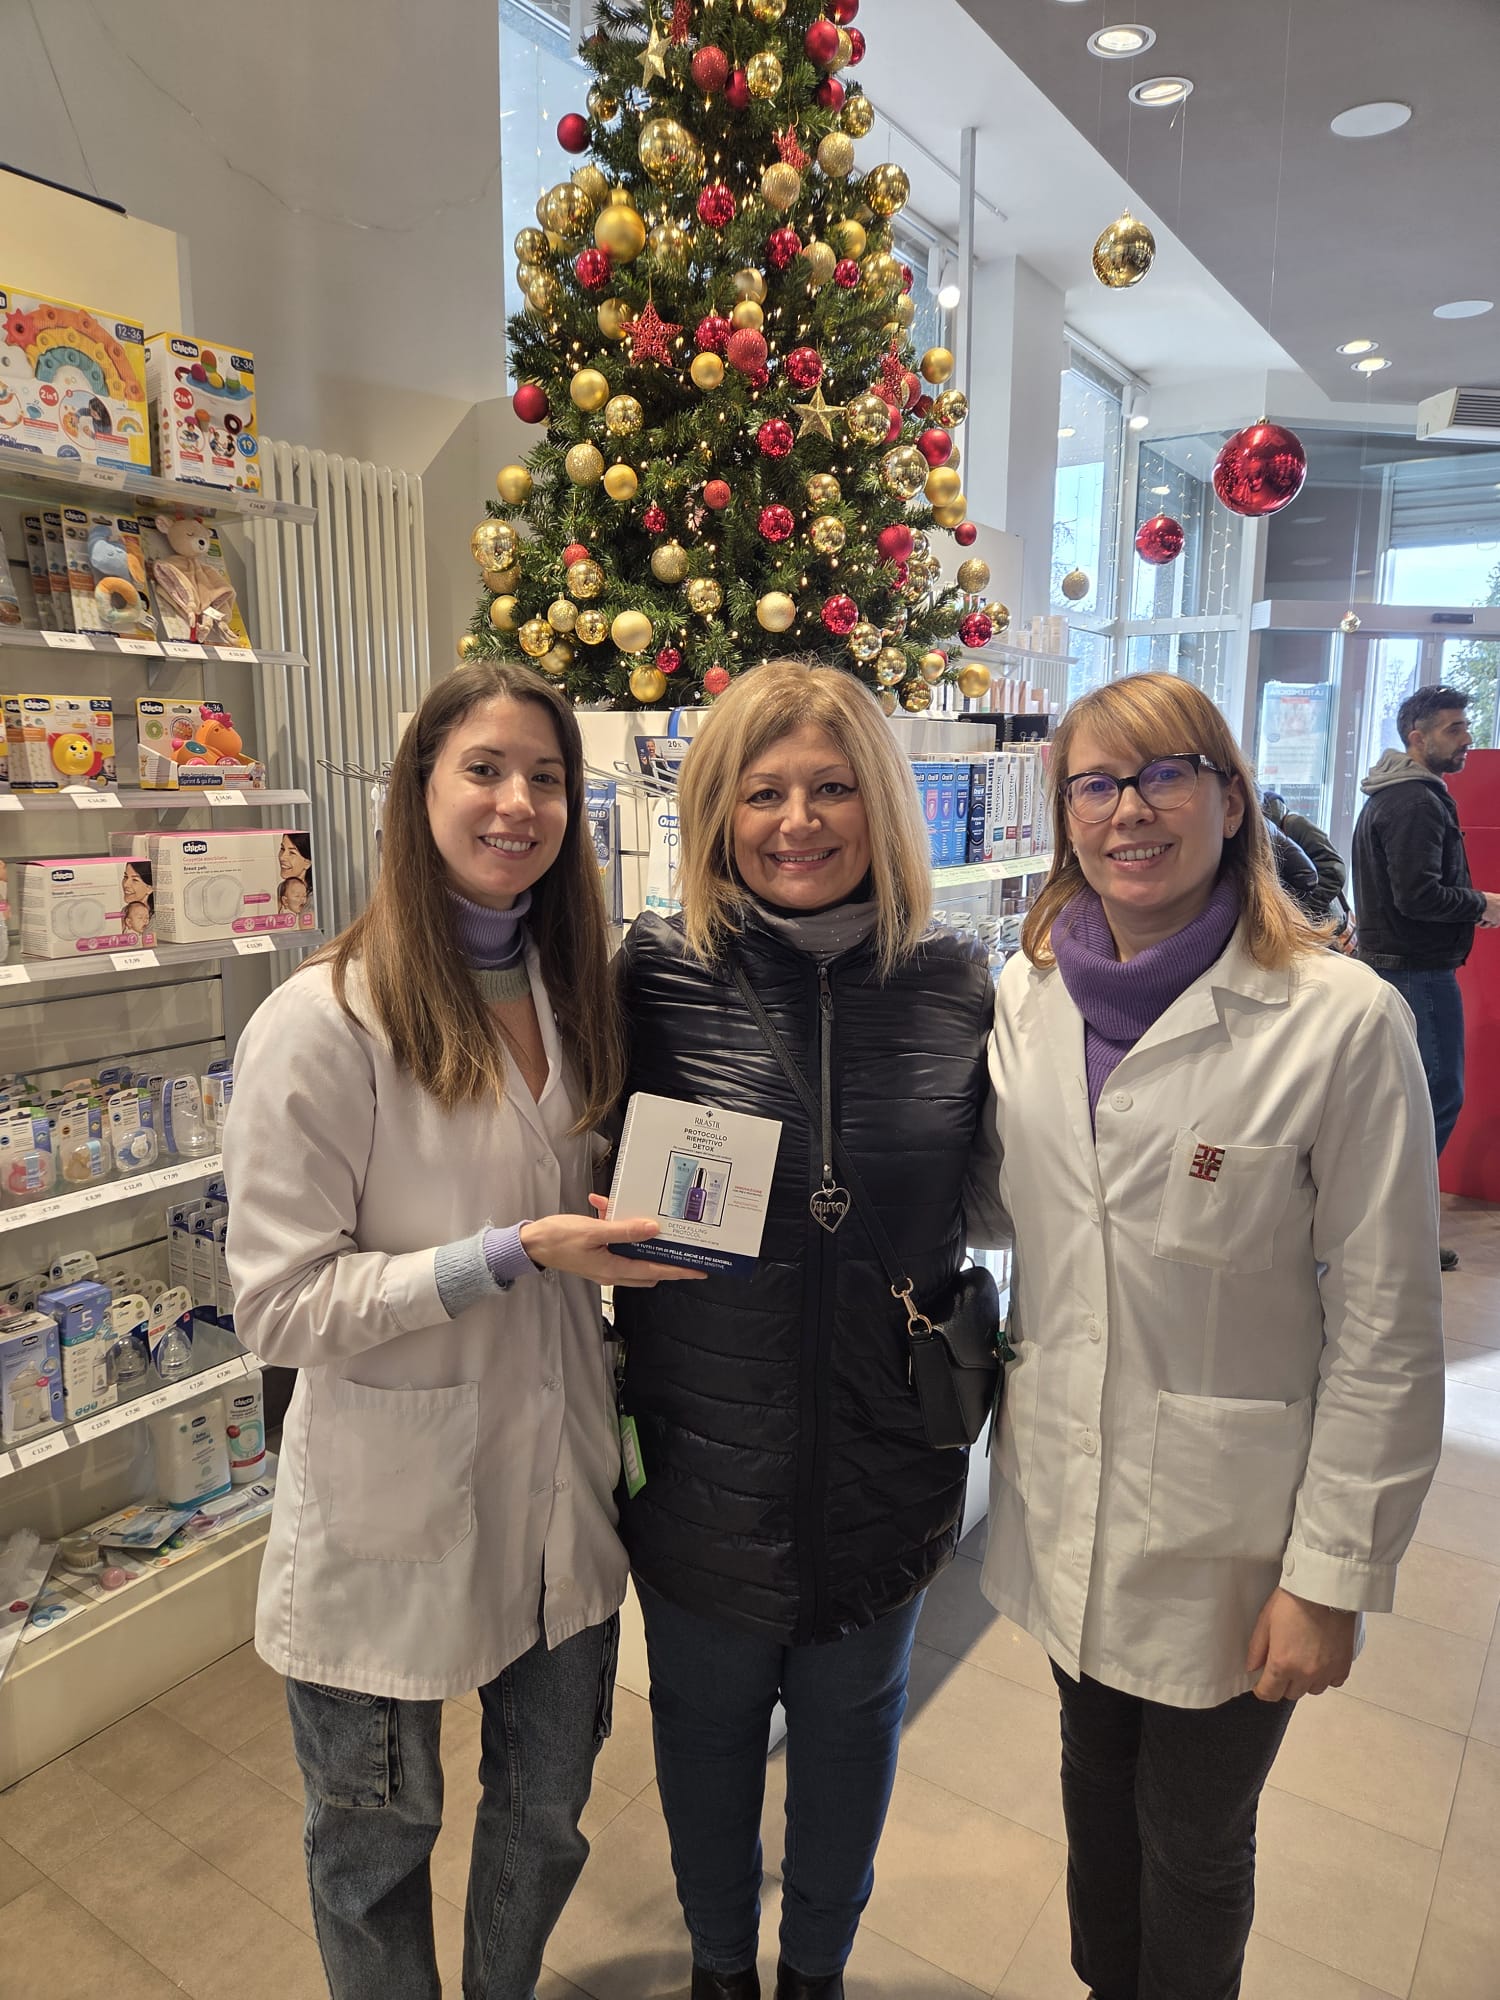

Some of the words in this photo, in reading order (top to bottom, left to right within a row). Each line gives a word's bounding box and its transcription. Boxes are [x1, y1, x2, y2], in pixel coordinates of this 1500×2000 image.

[117, 325, 142, 341] 12-36
[172, 342, 198, 357] chicco
[65, 510, 86, 523] chicco
[141, 702, 163, 713] chicco
[986, 758, 995, 818] Biorepair
[184, 842, 207, 853] chicco
[684, 1128, 728, 1142] PROTOCOLLO
[686, 1135, 723, 1147] RIEMPITIVO
[692, 1143, 714, 1152] DETOX
[80, 1309, 94, 1332] 5
